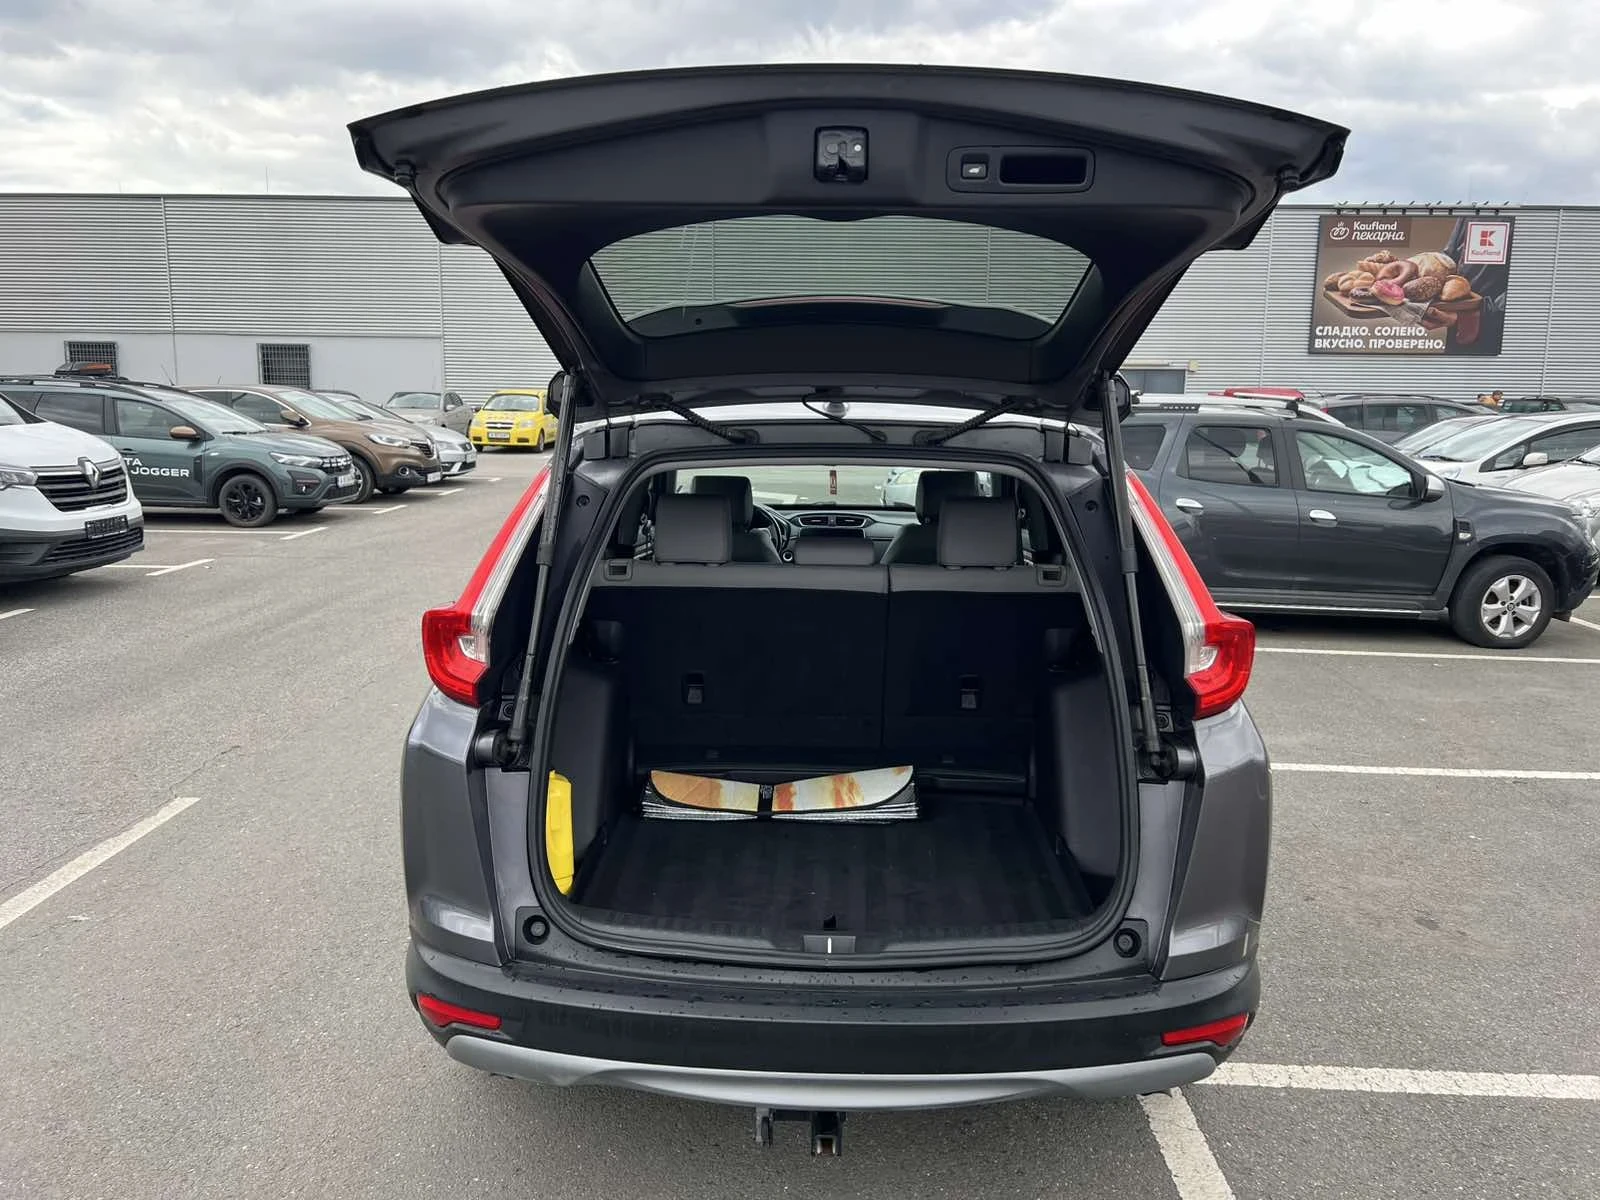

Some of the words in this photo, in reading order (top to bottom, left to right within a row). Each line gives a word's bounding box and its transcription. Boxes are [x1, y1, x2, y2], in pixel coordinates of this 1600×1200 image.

[1353, 221, 1397, 230] Kaufland
[1352, 232, 1405, 242] пекарна
[1315, 326, 1372, 338] СЛАДКО.
[1374, 326, 1428, 337] СОЛЕНО.
[1314, 338, 1366, 349] ВКУСНО.
[1368, 338, 1446, 349] ПРОВЕРЕНО.
[130, 466, 190, 477] JOGGER
